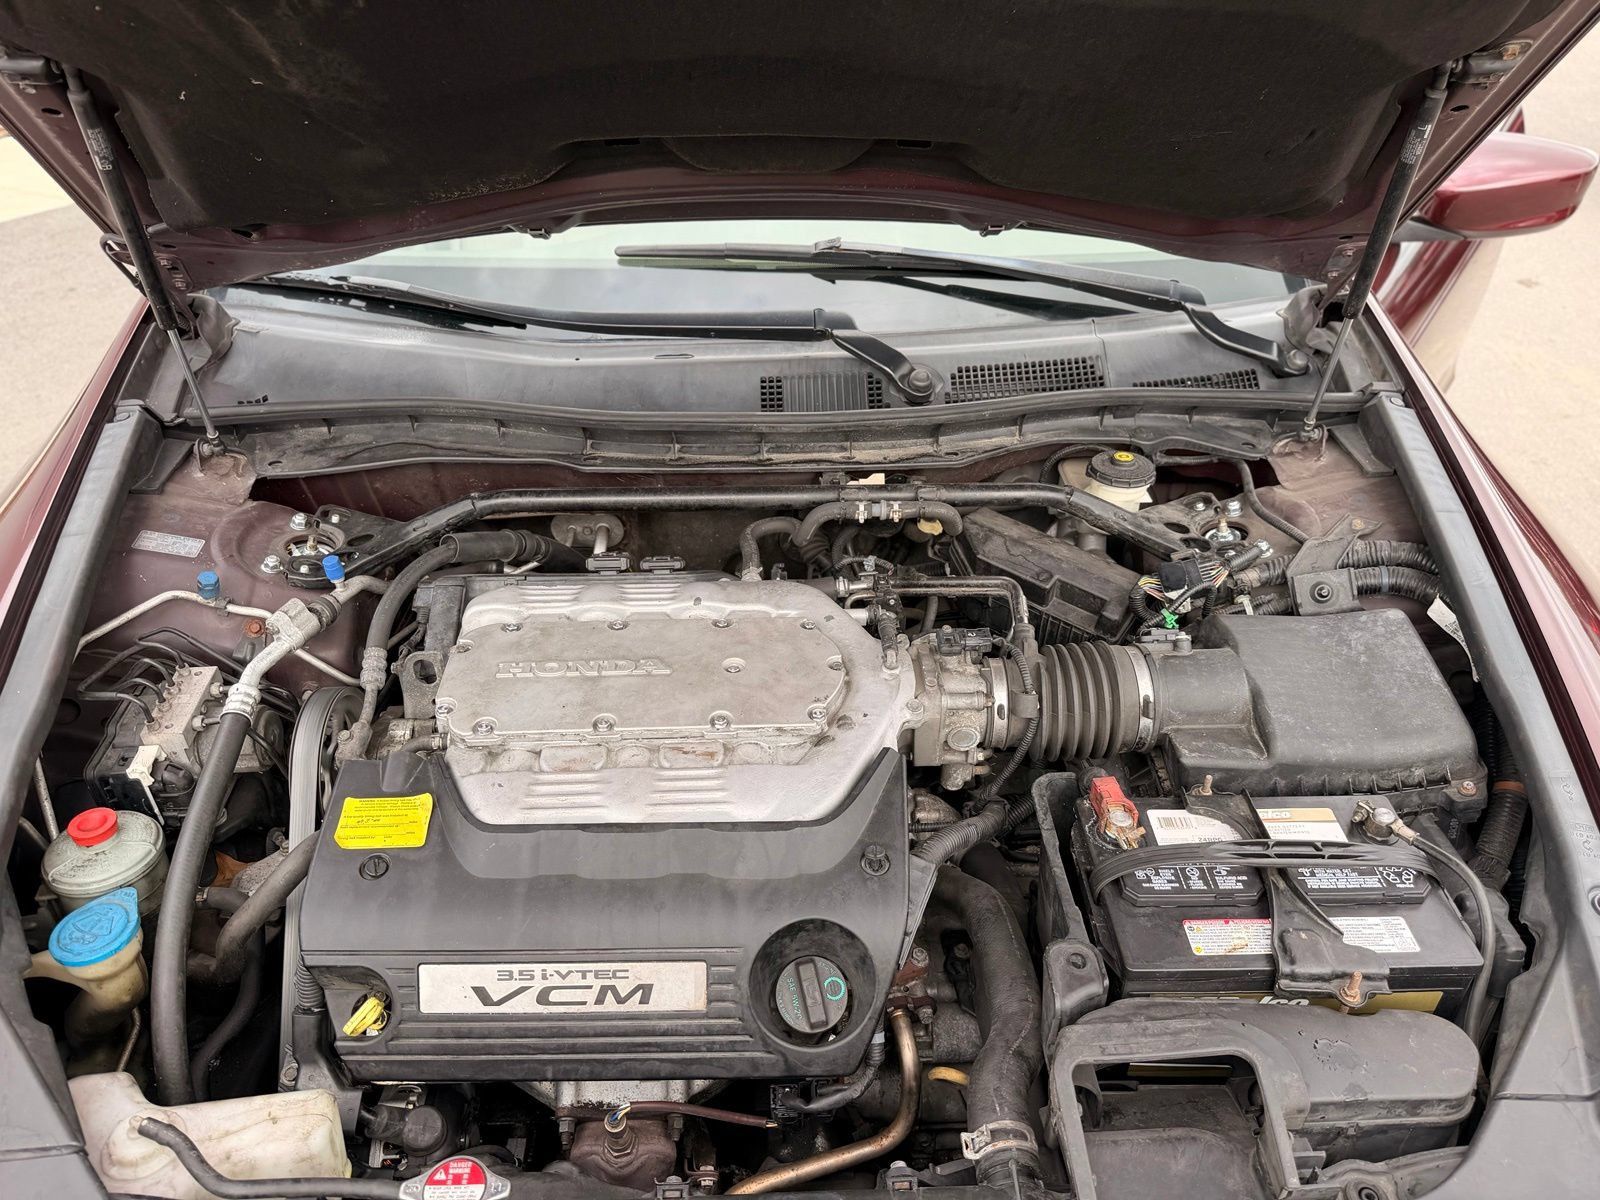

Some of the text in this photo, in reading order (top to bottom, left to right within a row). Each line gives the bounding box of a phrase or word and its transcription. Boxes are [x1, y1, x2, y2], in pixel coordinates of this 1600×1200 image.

[495, 658, 672, 678] HONDA
[496, 969, 630, 981] 3.5 i-VTEC
[470, 984, 654, 1006] VCM
